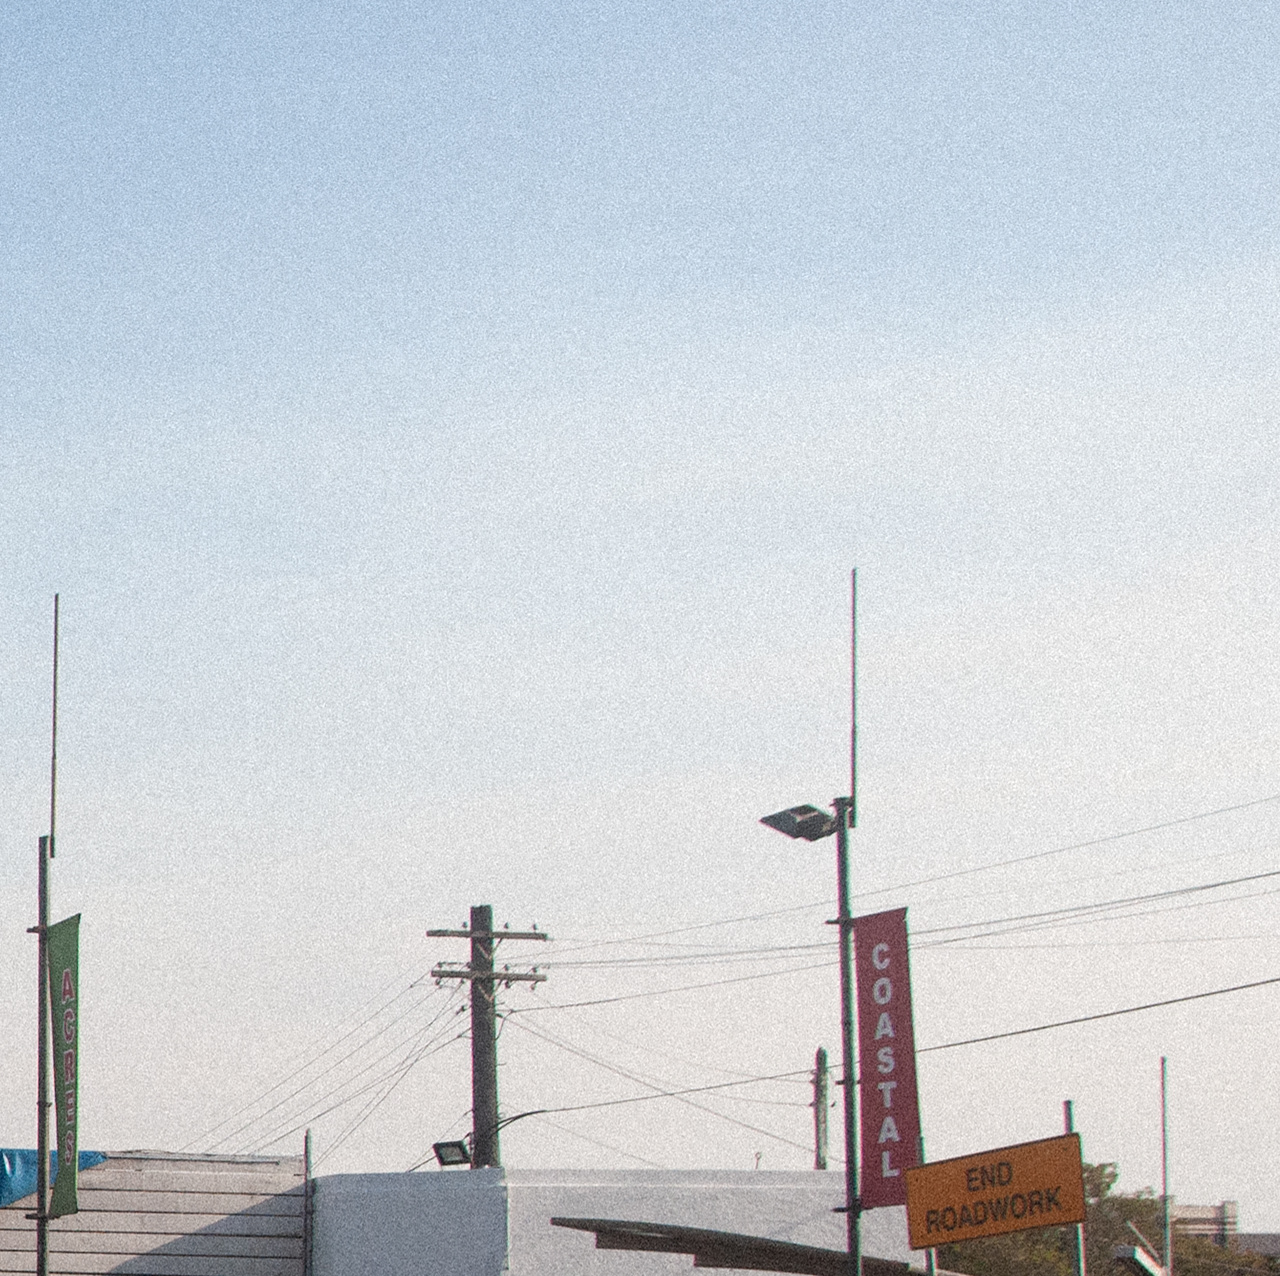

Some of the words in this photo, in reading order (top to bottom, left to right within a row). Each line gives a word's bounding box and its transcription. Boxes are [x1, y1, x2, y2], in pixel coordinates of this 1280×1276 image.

[871, 942, 901, 1179] COASTAL
[966, 1161, 1013, 1192] END
[926, 1186, 1062, 1234] ROADWORK
